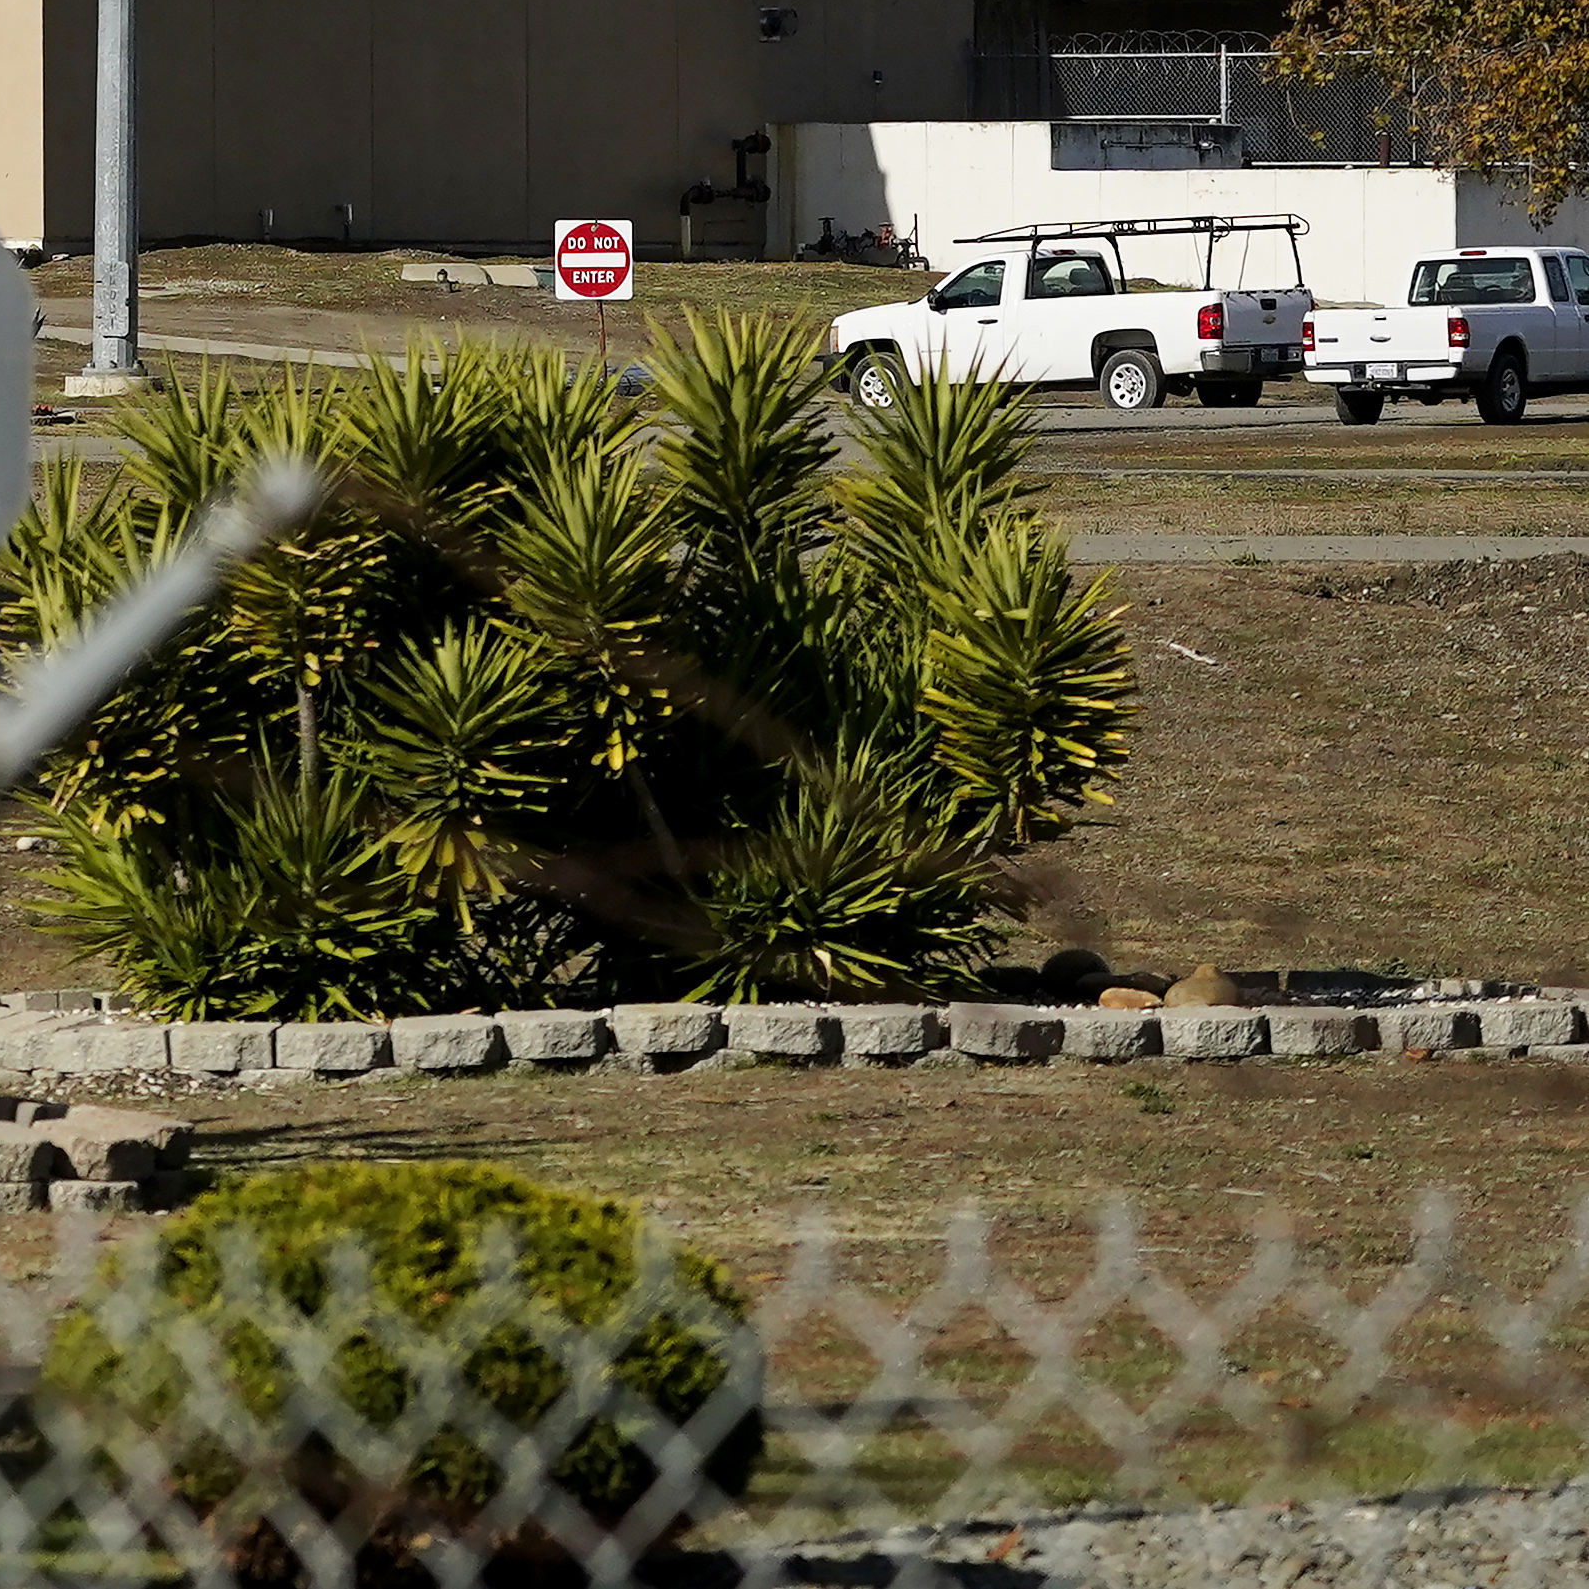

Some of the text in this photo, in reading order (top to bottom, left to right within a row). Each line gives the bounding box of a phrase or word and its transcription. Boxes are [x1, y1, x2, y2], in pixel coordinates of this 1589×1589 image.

[568, 236, 621, 250] DO NOT
[572, 270, 616, 284] ENTER
